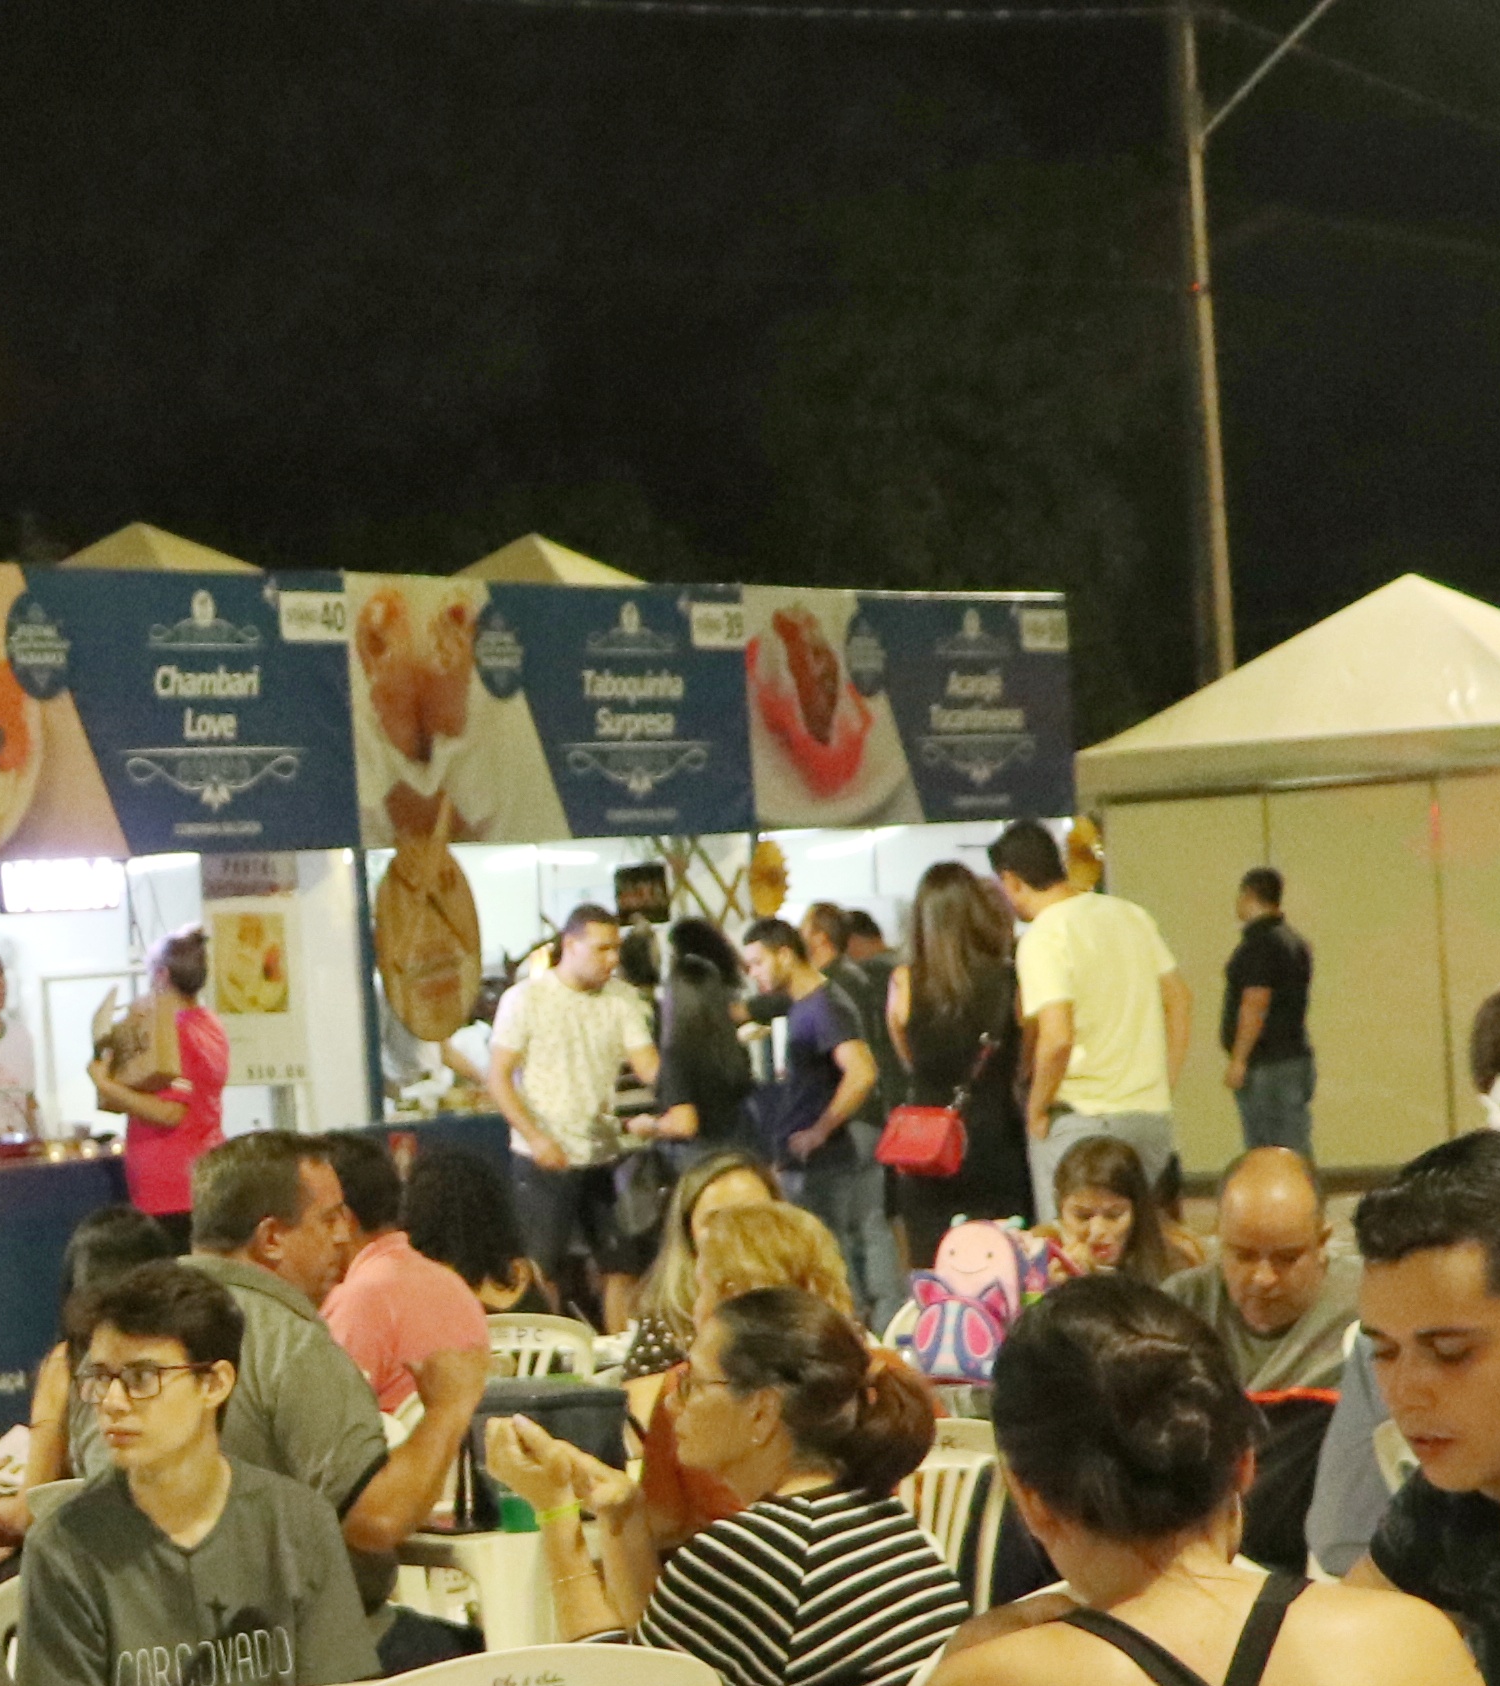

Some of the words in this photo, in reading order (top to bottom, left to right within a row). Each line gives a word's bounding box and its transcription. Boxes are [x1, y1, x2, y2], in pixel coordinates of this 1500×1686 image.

[319, 602, 346, 632] 40
[153, 664, 260, 698] Chambari
[582, 668, 684, 707] Taboquinha
[182, 706, 238, 739] Love
[595, 705, 676, 741] Surpresa
